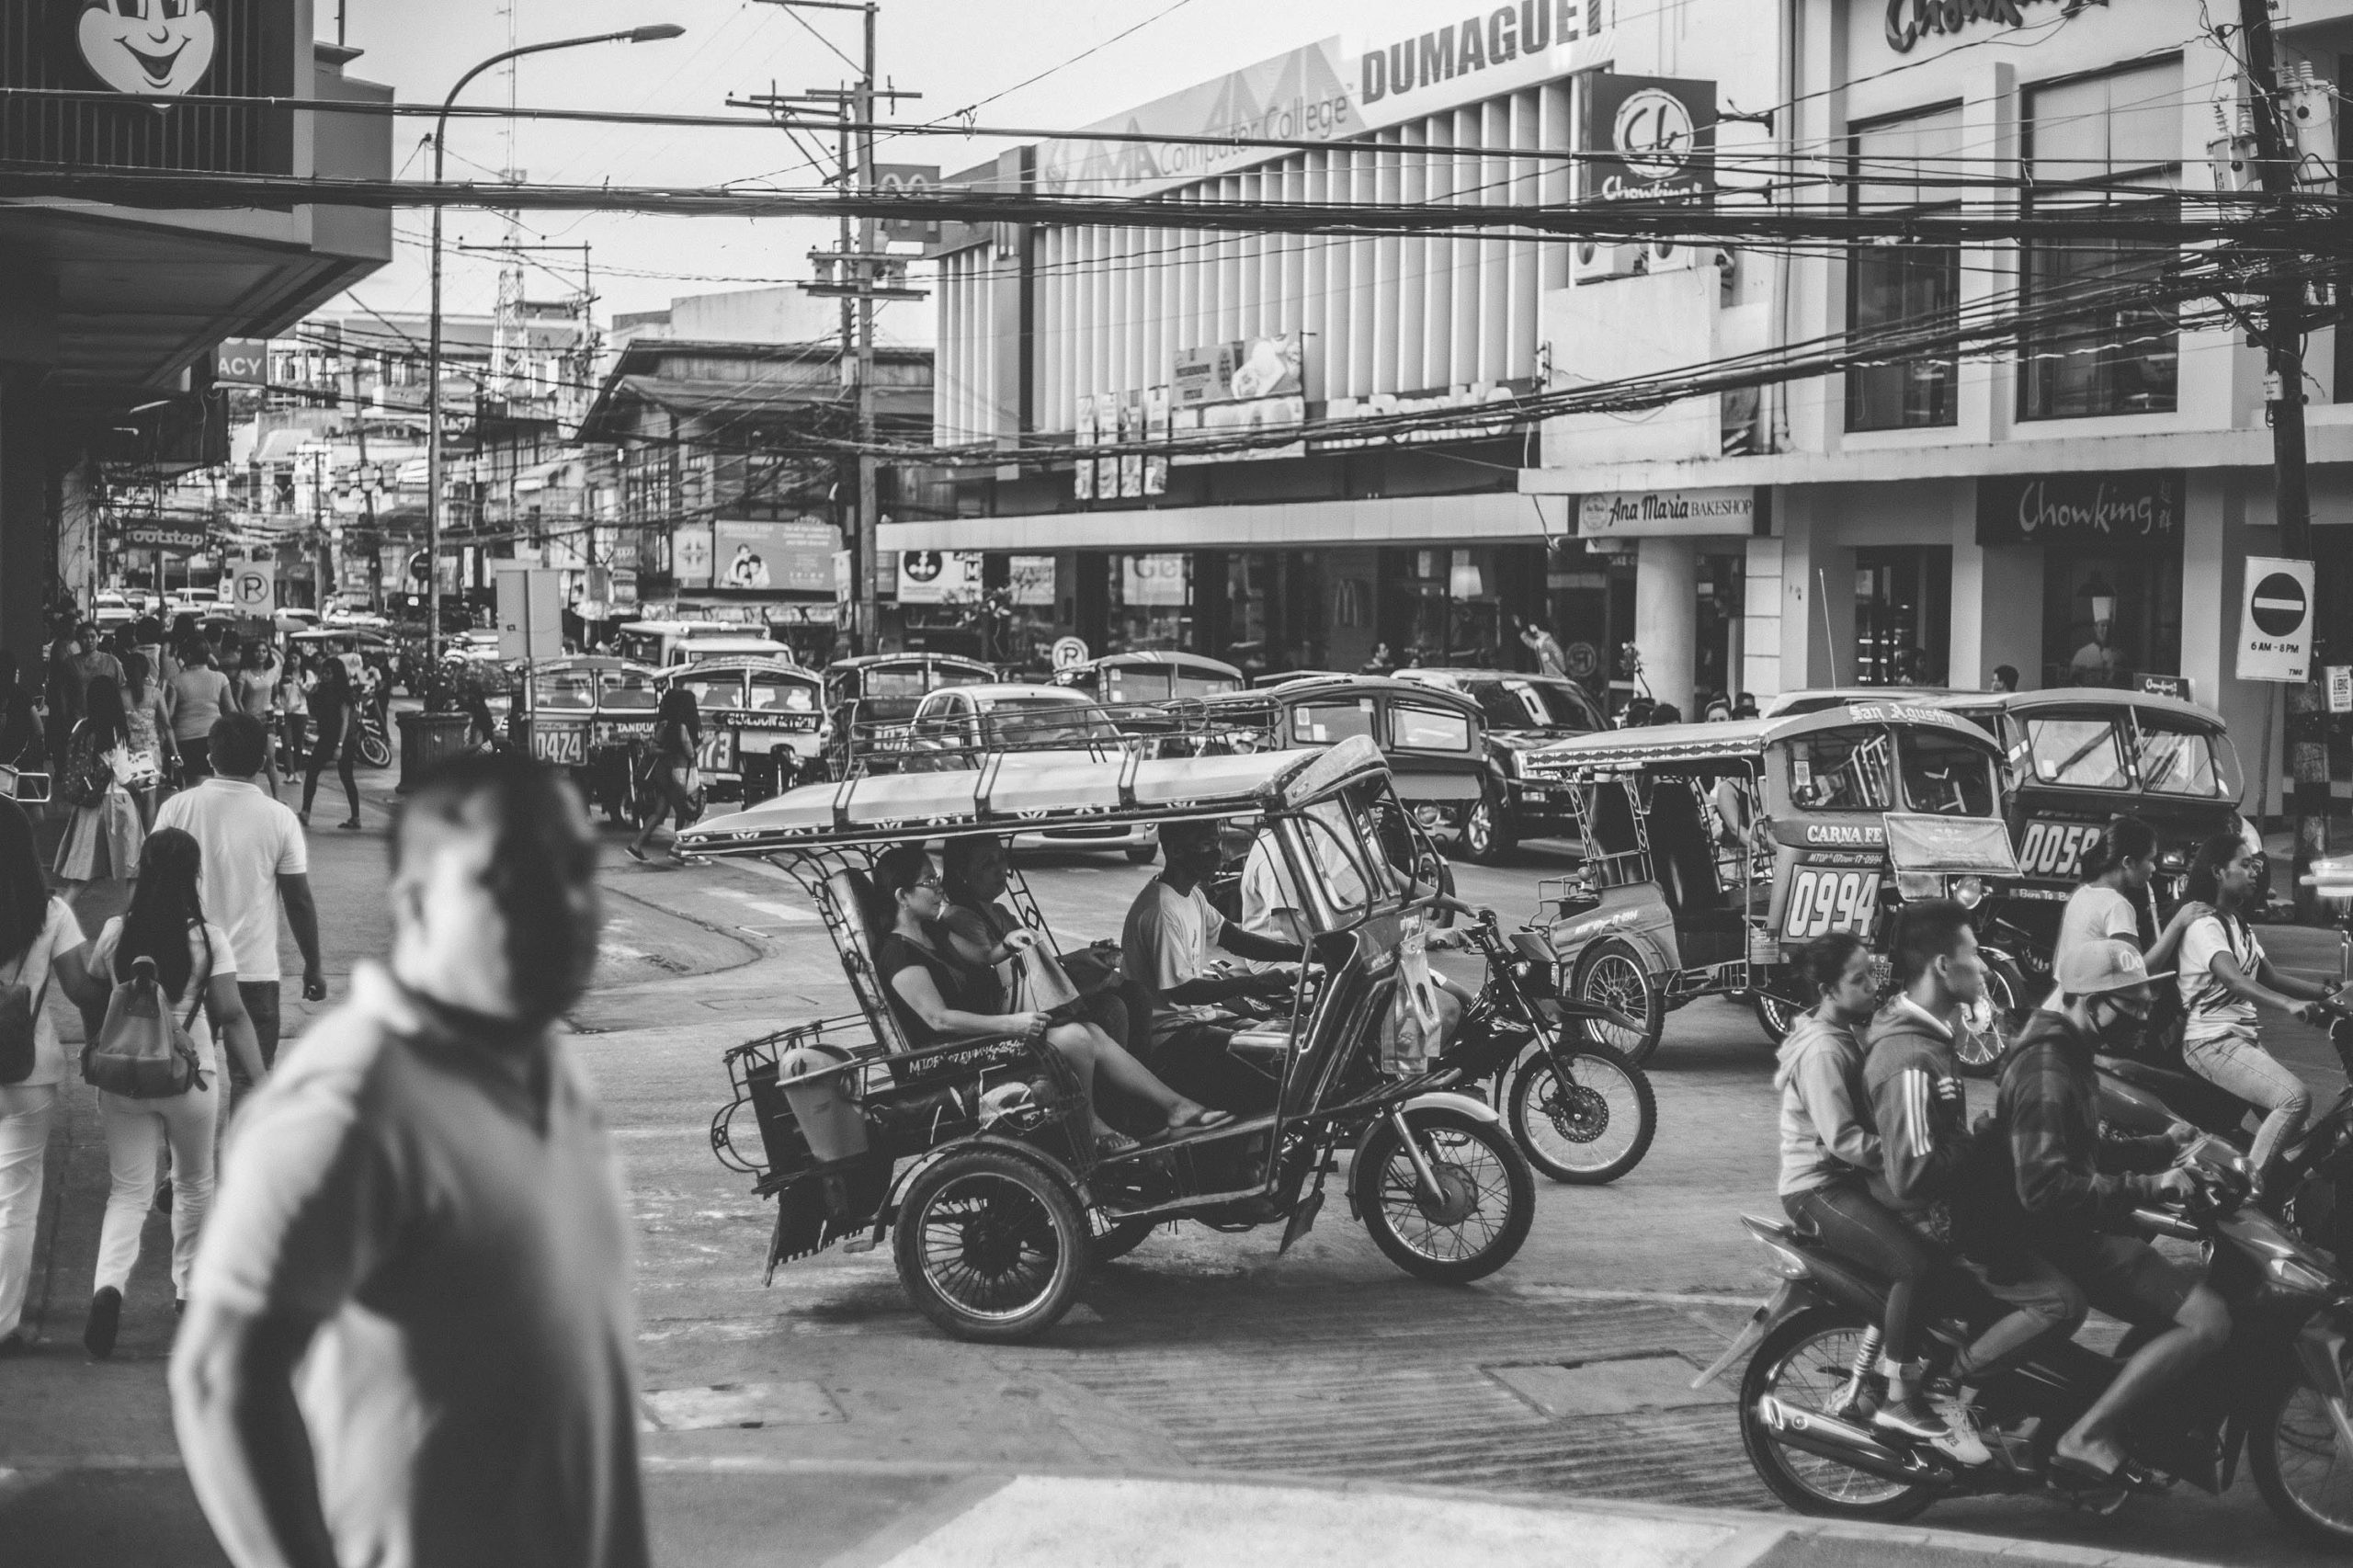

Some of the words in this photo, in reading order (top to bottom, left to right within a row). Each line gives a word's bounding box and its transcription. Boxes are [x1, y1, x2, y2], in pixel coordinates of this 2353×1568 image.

[1264, 96, 1347, 140] College
[1608, 496, 1638, 527] Ana
[1642, 494, 1688, 520] Maria
[1691, 499, 1753, 517] BAKESHOP
[2019, 481, 2153, 535] Chowking
[2251, 642, 2257, 650] 6
[2258, 642, 2271, 651] AM
[2279, 643, 2285, 653] 8
[2286, 644, 2300, 653] PM
[616, 722, 656, 733] TANDUA
[1849, 705, 1884, 722] San
[1889, 702, 1957, 728] Agustin
[536, 732, 581, 764] 0474
[1807, 824, 1863, 844] CARNA
[1865, 826, 1883, 843] FE
[1787, 871, 1881, 937] 0994
